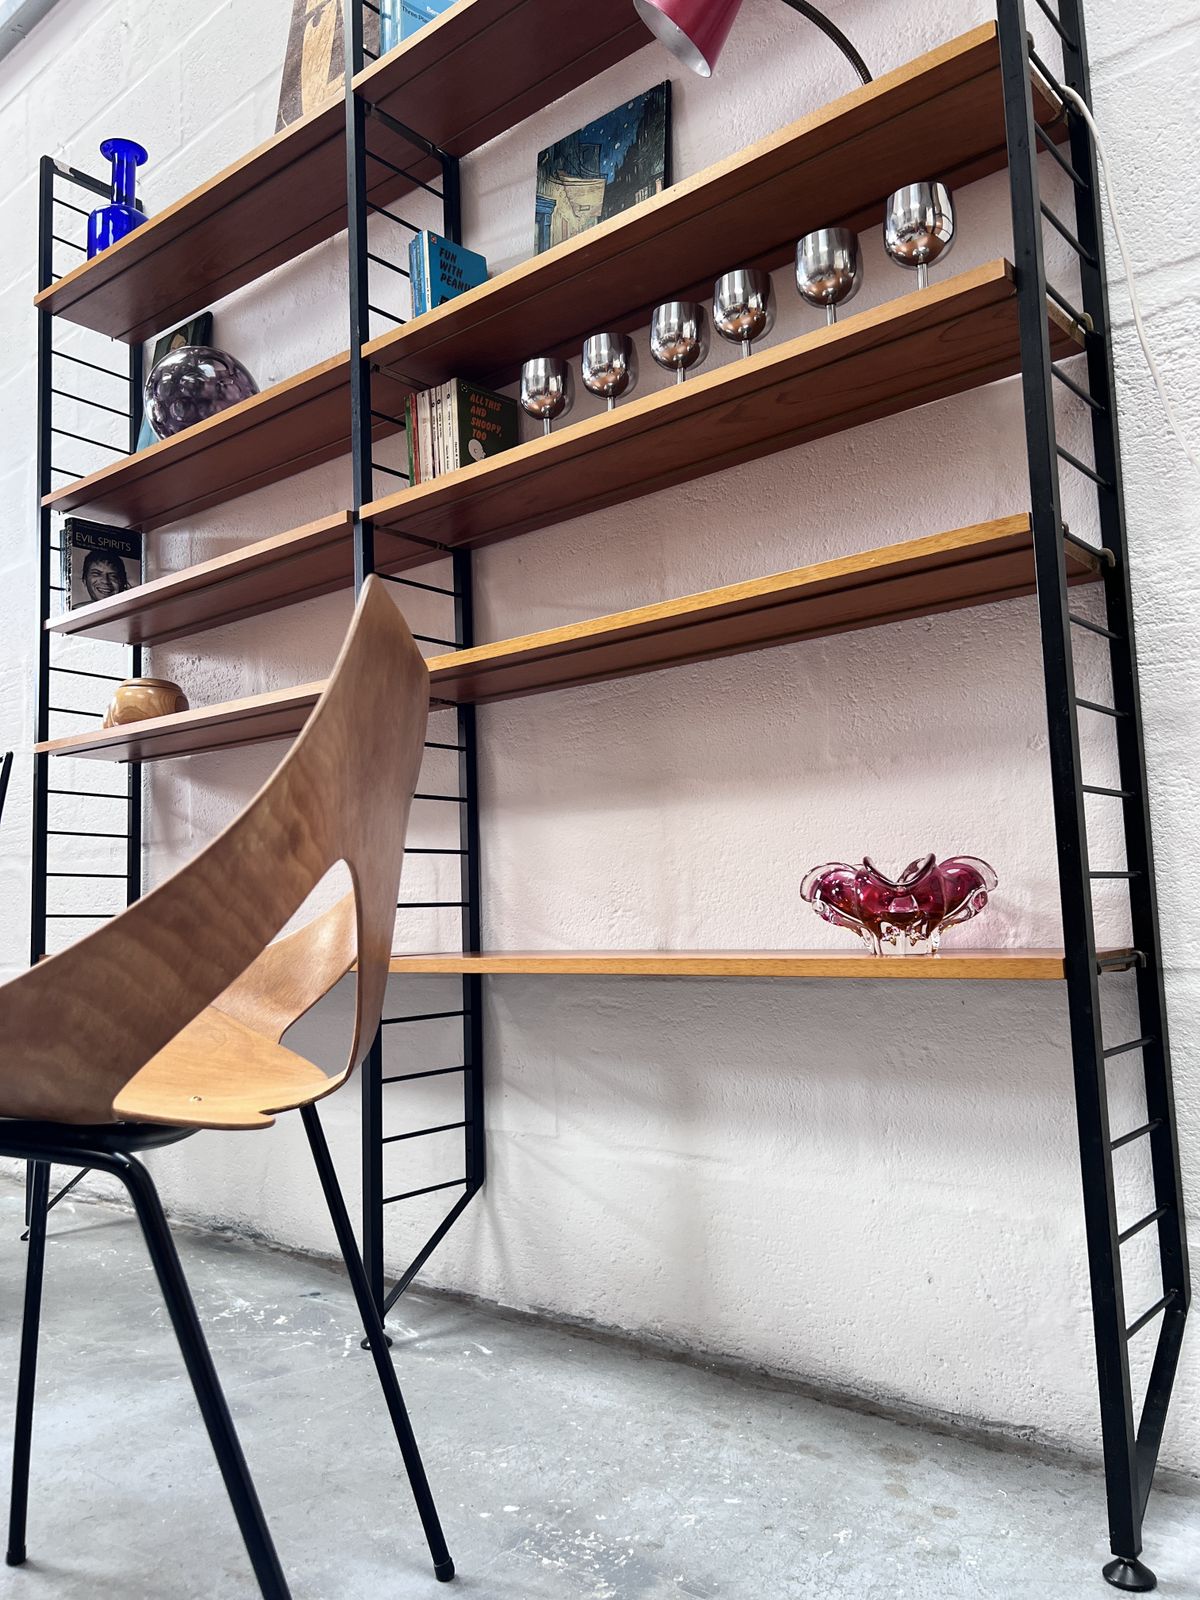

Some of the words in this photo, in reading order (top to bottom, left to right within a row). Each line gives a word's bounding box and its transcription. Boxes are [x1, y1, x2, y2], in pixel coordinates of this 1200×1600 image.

[440, 248, 457, 262] FUN
[440, 260, 463, 278] WITH
[440, 273, 474, 291] PEANU
[471, 406, 487, 417] AND
[471, 417, 502, 437] SNOOPY,
[472, 428, 487, 441] TOO
[75, 532, 96, 545] EVIL
[98, 537, 132, 552] SPIRITS
